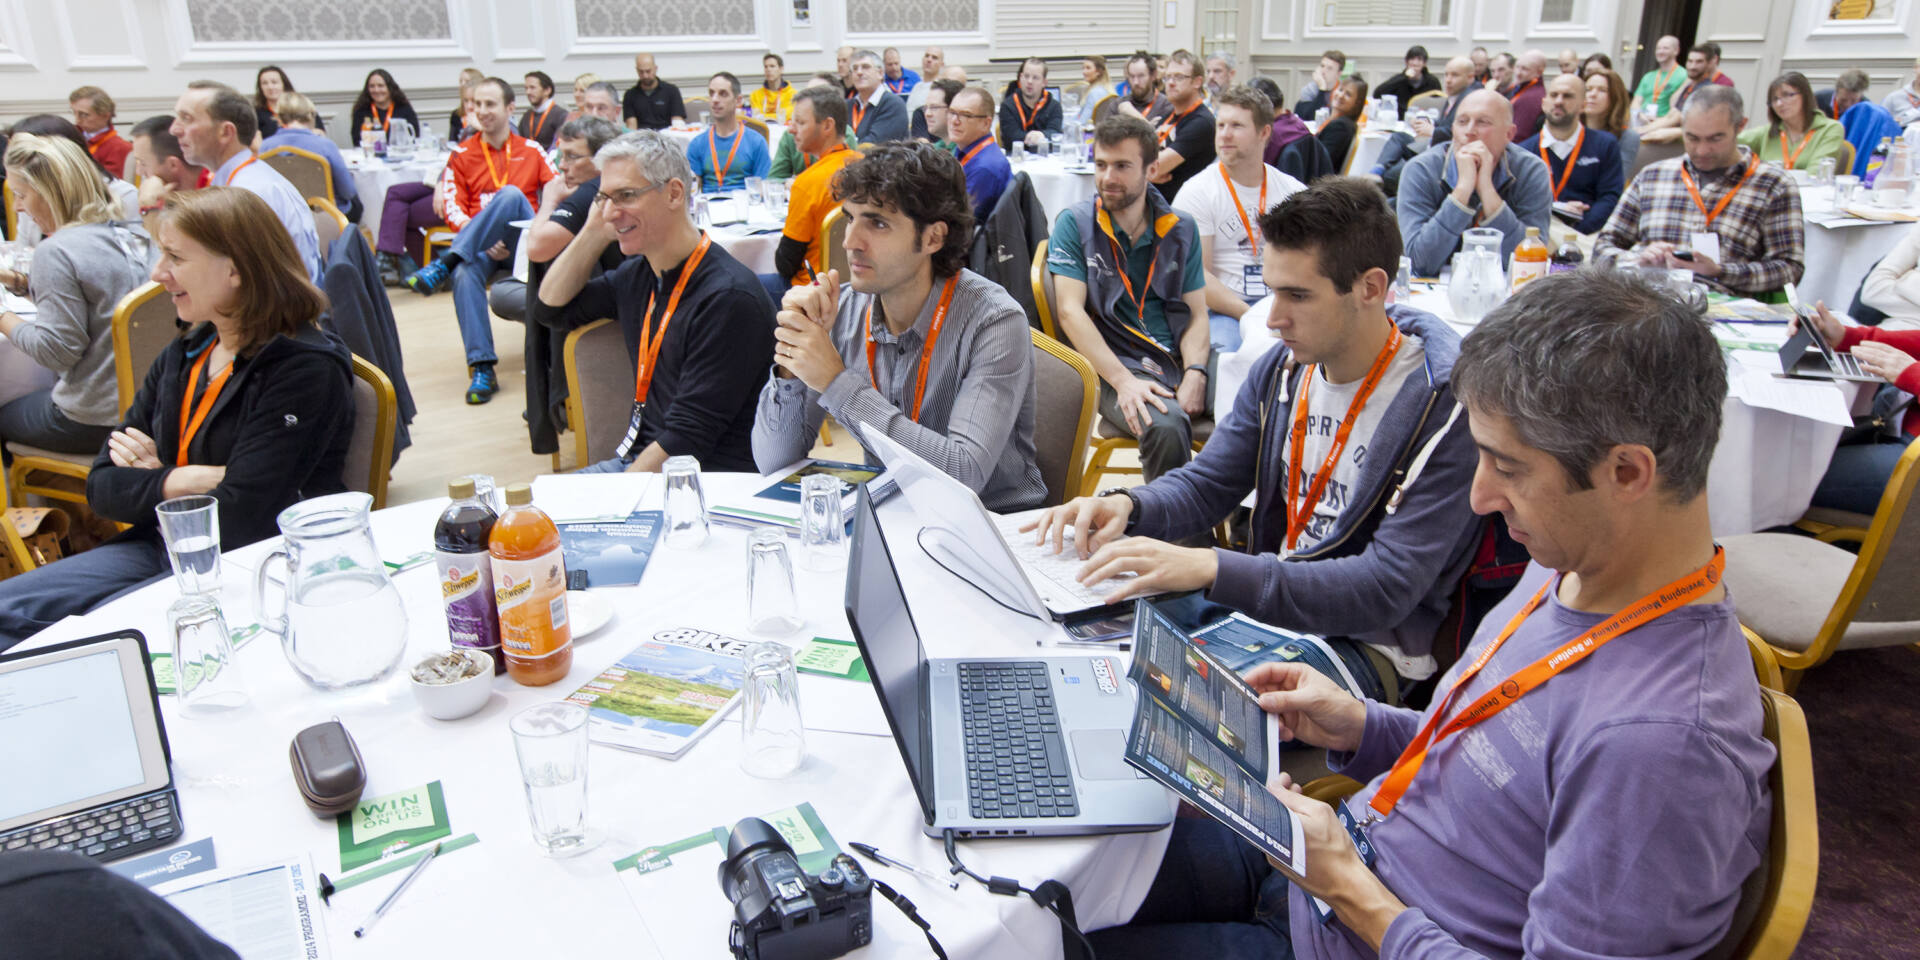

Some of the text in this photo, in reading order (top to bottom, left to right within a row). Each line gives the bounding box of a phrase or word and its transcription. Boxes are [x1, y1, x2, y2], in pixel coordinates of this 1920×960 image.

[1619, 599, 1662, 625] Mountain
[1583, 637, 1594, 647] in
[1548, 643, 1585, 670] Scotland
[1464, 697, 1500, 721] Develop
[1169, 771, 1193, 790] DAY
[360, 794, 418, 816] WIN
[296, 894, 314, 941] PROGRAMME
